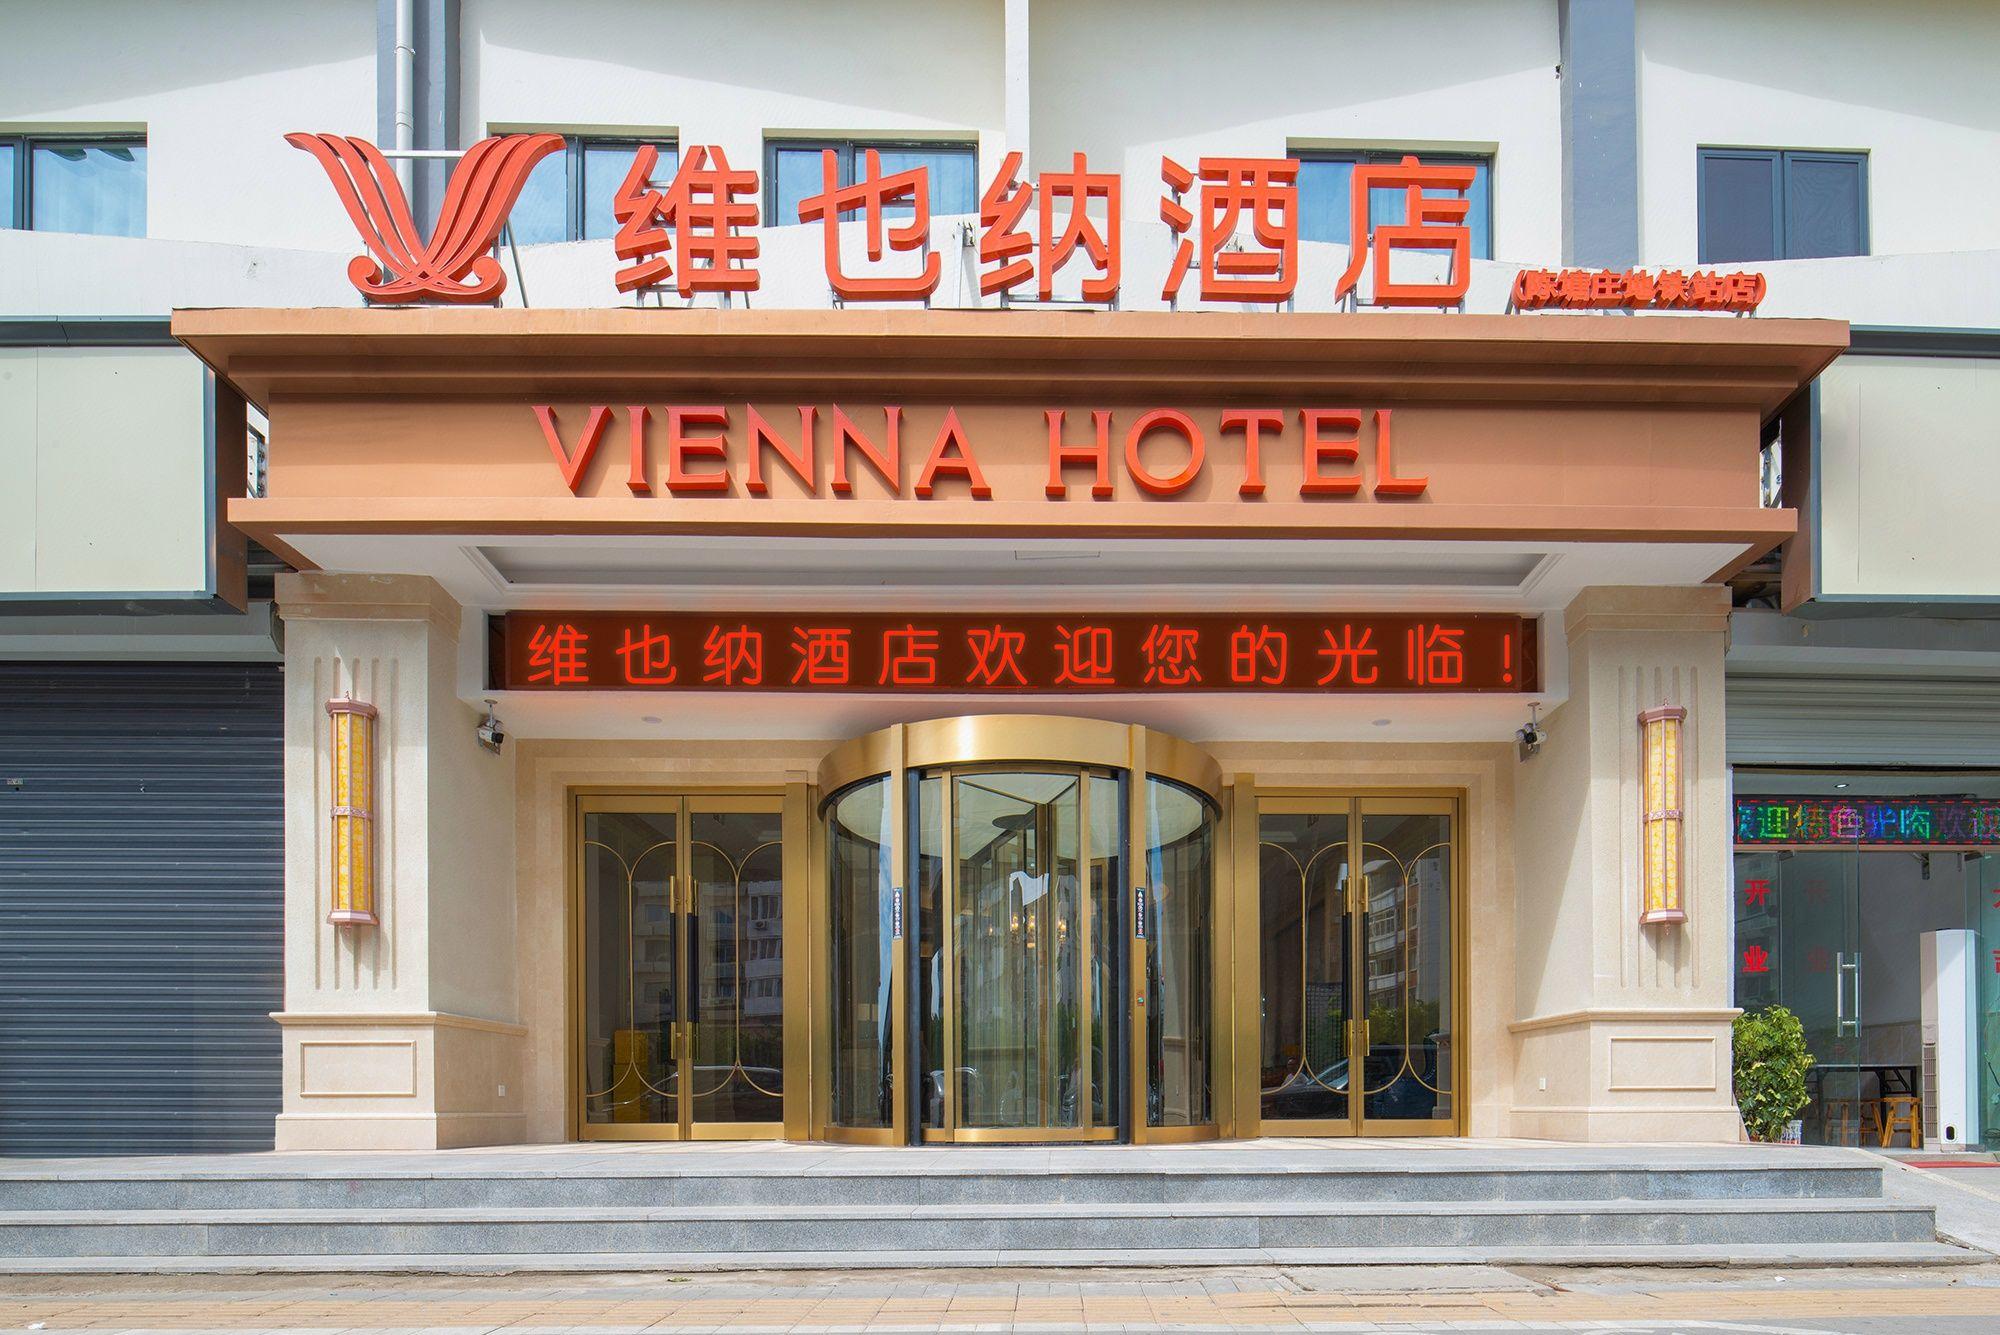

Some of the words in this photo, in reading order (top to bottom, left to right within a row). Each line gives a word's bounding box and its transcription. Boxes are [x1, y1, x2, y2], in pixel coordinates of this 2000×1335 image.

[614, 145, 1477, 306] 维也纳酒店
[531, 402, 992, 500] VIENNA
[1044, 407, 1429, 497] HOTEL
[527, 624, 1513, 686] 维也纳酒店欢迎您的光临!
